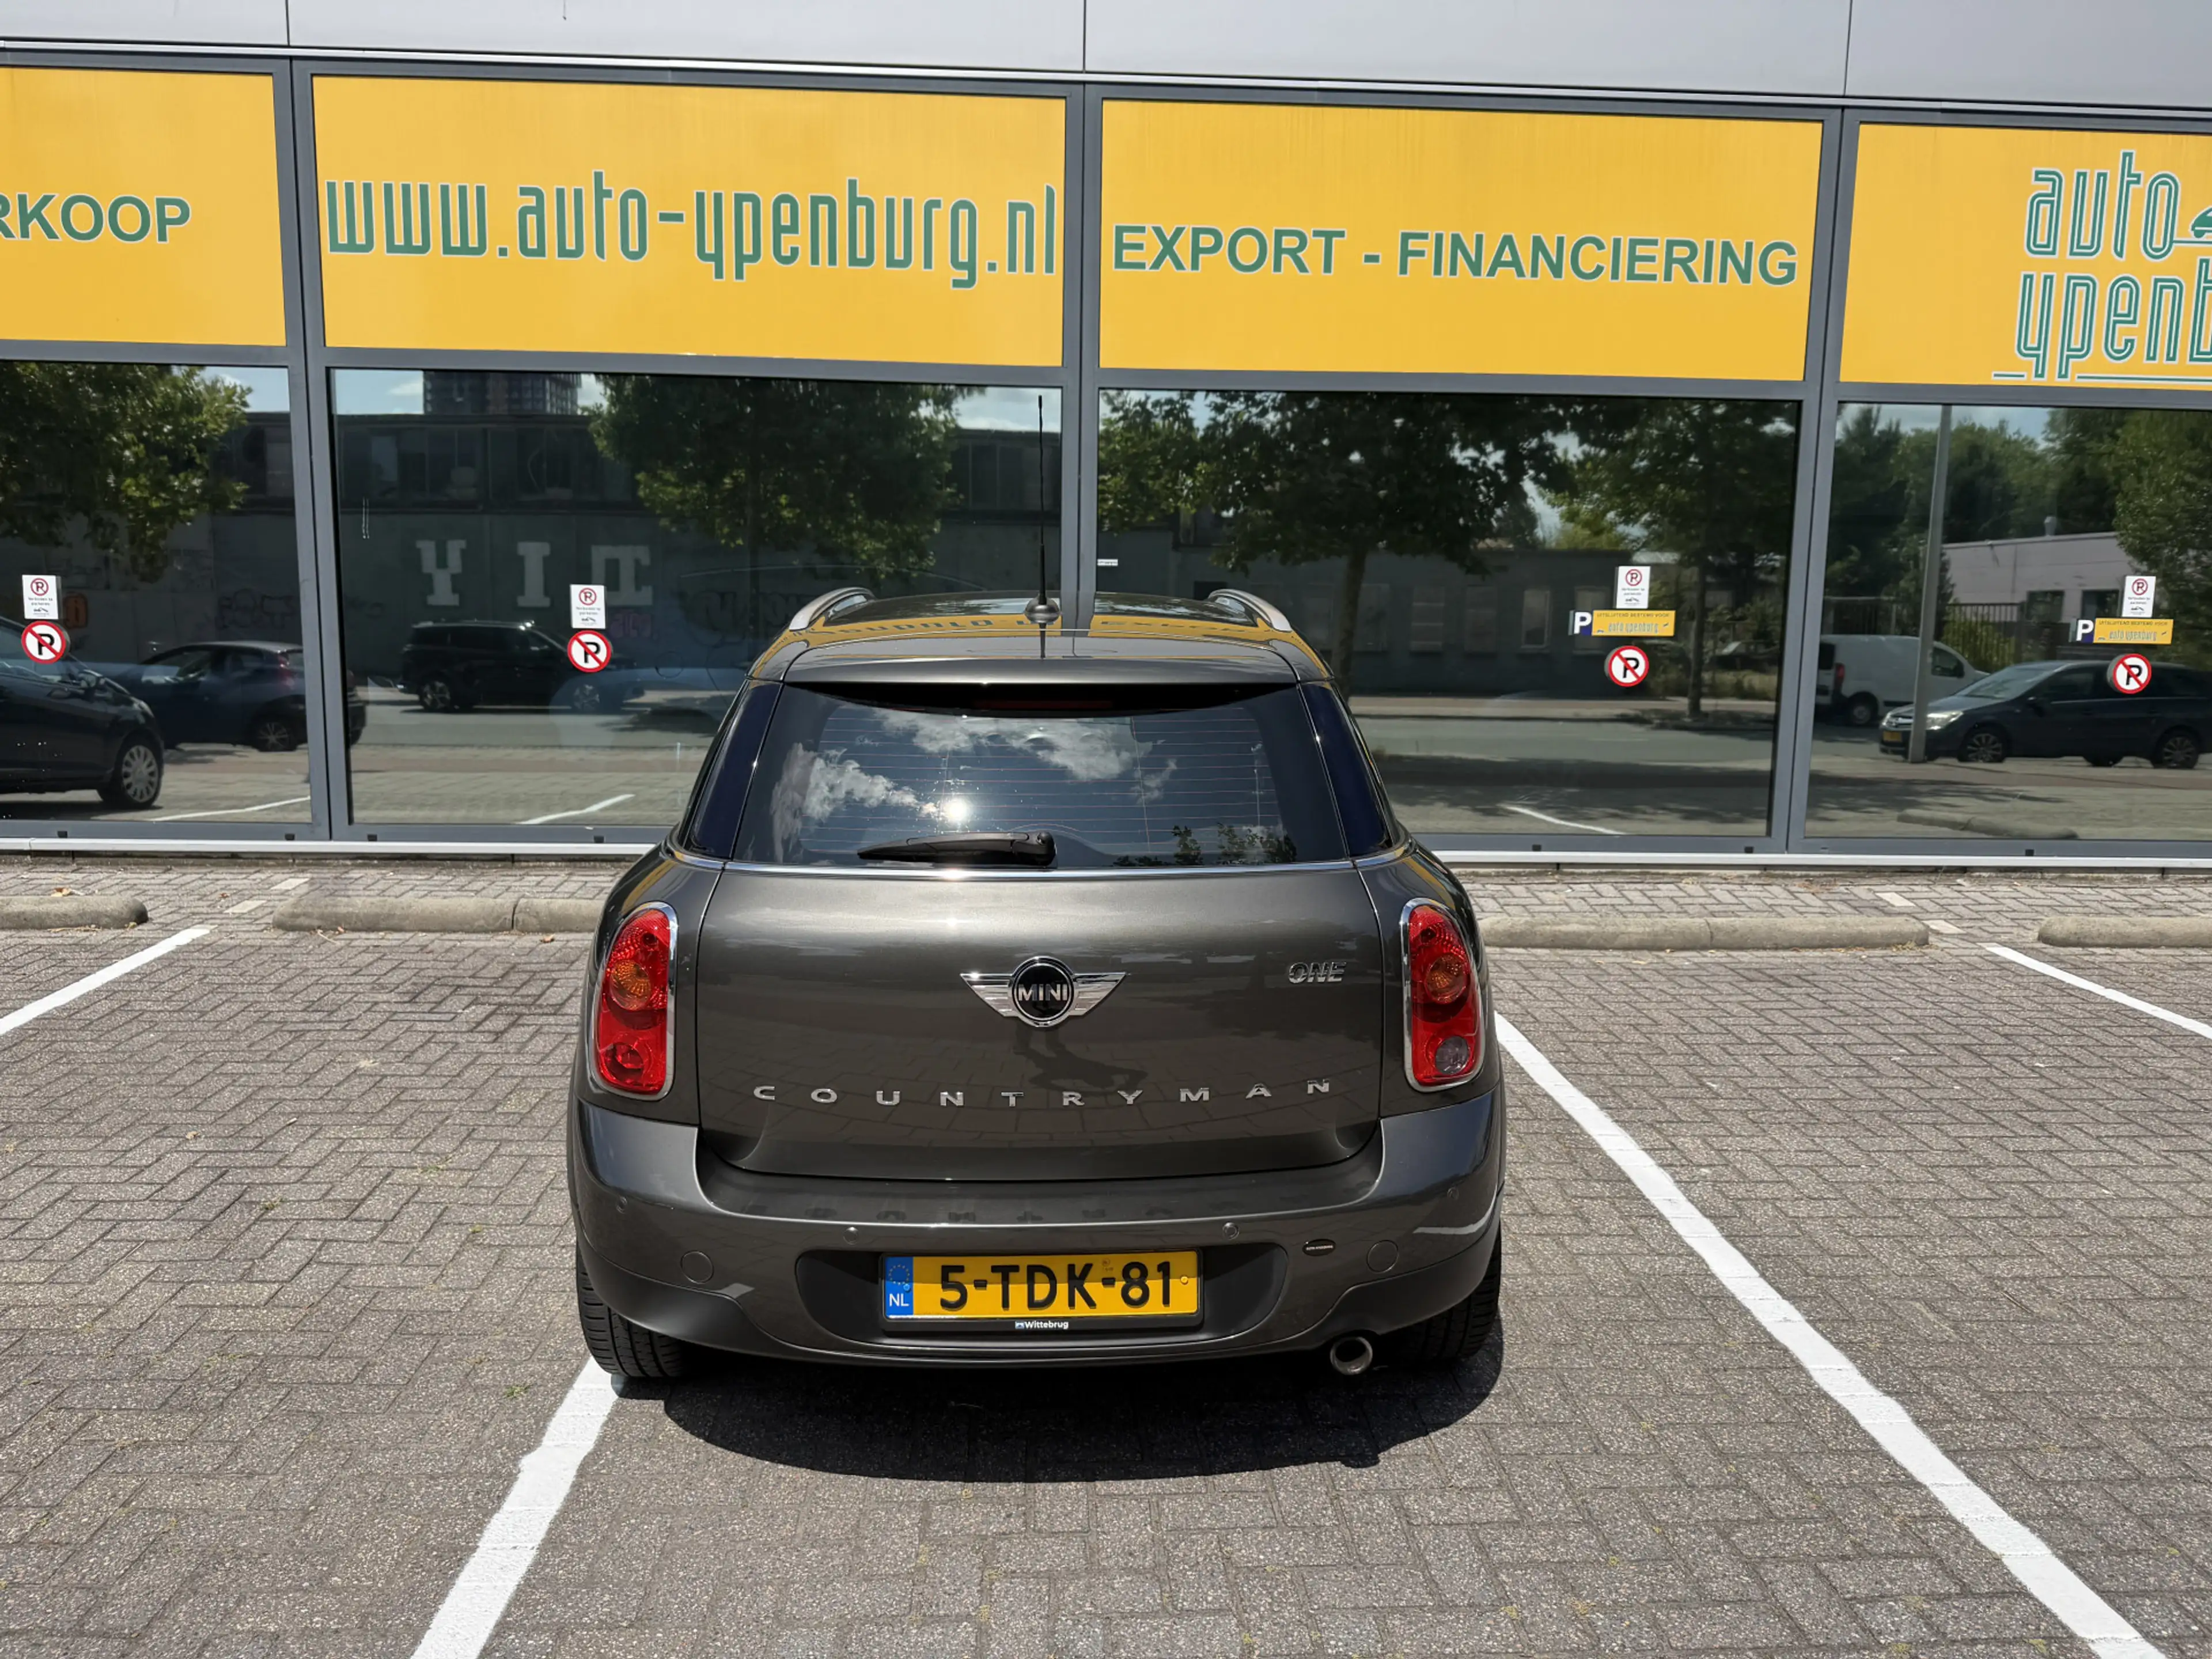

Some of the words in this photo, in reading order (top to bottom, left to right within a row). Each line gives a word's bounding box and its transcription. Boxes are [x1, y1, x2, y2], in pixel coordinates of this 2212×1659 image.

[2025, 150, 2180, 260] auto
[326, 171, 1056, 289] www.auto-ypenburg.nl
[1113, 225, 1346, 275] EXPORT
[1363, 253, 1381, 264] -
[1398, 232, 1797, 286] FINANCIERING
[1289, 961, 1347, 984] ONE
[1018, 983, 1068, 1001] MINI
[753, 1079, 1331, 1107] COUNTRYMAN
[889, 1293, 909, 1307] NL
[940, 1261, 1171, 1310] 5-TDK-81
[1024, 1320, 1069, 1330] Wittebrug
